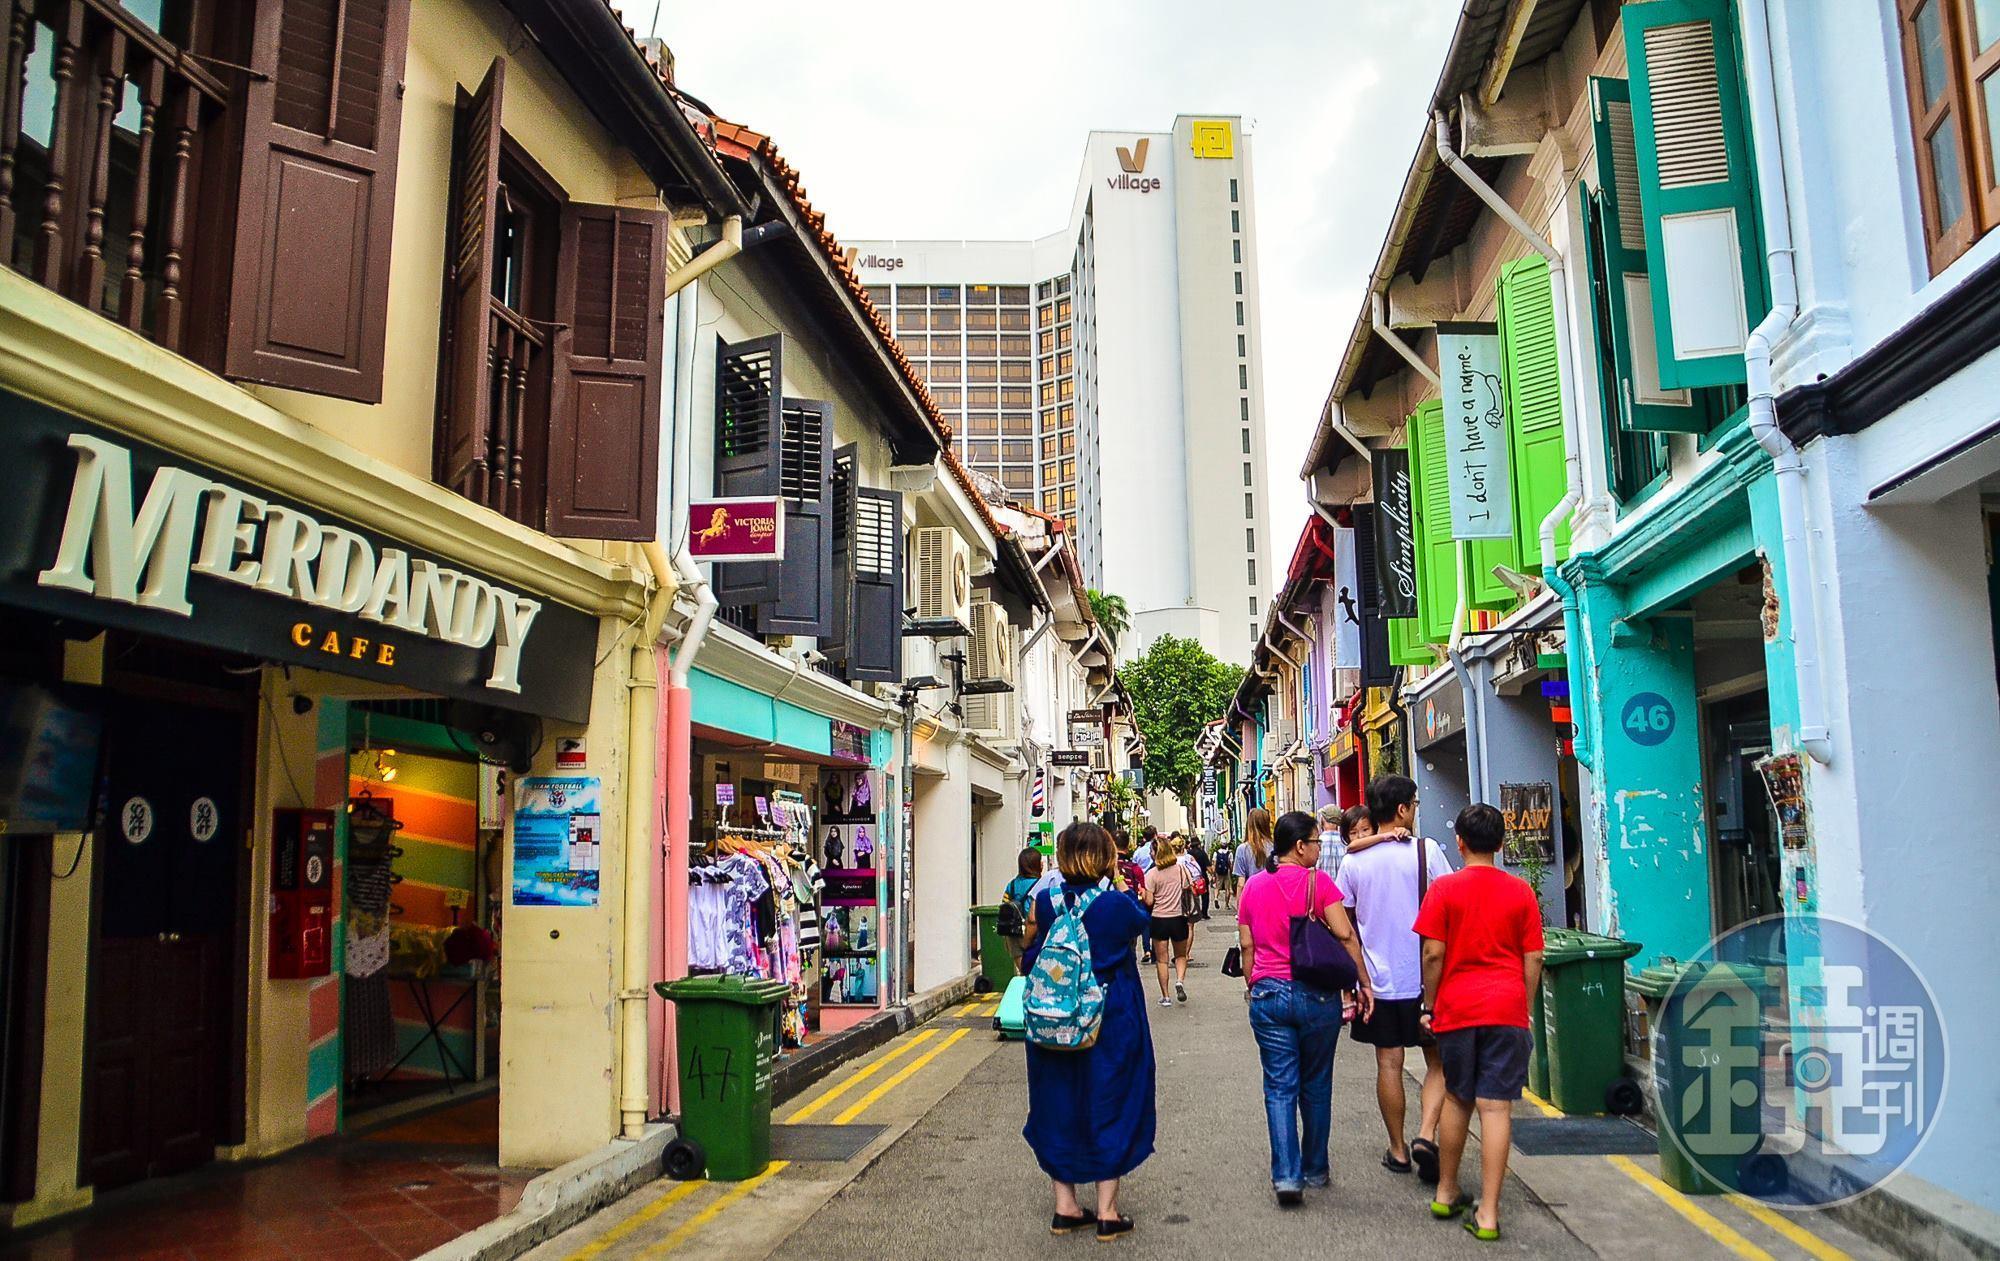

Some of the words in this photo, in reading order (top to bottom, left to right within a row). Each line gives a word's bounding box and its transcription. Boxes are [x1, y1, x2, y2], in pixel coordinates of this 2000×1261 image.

[1106, 174, 1161, 194] village
[858, 254, 904, 271] village
[1457, 344, 1476, 394] name.
[1462, 399, 1475, 410] a
[1459, 413, 1485, 455] have
[734, 517, 775, 527] VICTORIA
[1468, 509, 1490, 522] I
[750, 524, 775, 533] JOMO
[1379, 469, 1417, 600] Simplicity
[37, 432, 542, 694] MERDANDY
[290, 622, 397, 667] CAFE
[1626, 704, 1670, 733] 46
[1503, 808, 1551, 831] RAW
[1582, 980, 1604, 998] 49
[687, 1044, 738, 1103] 47
